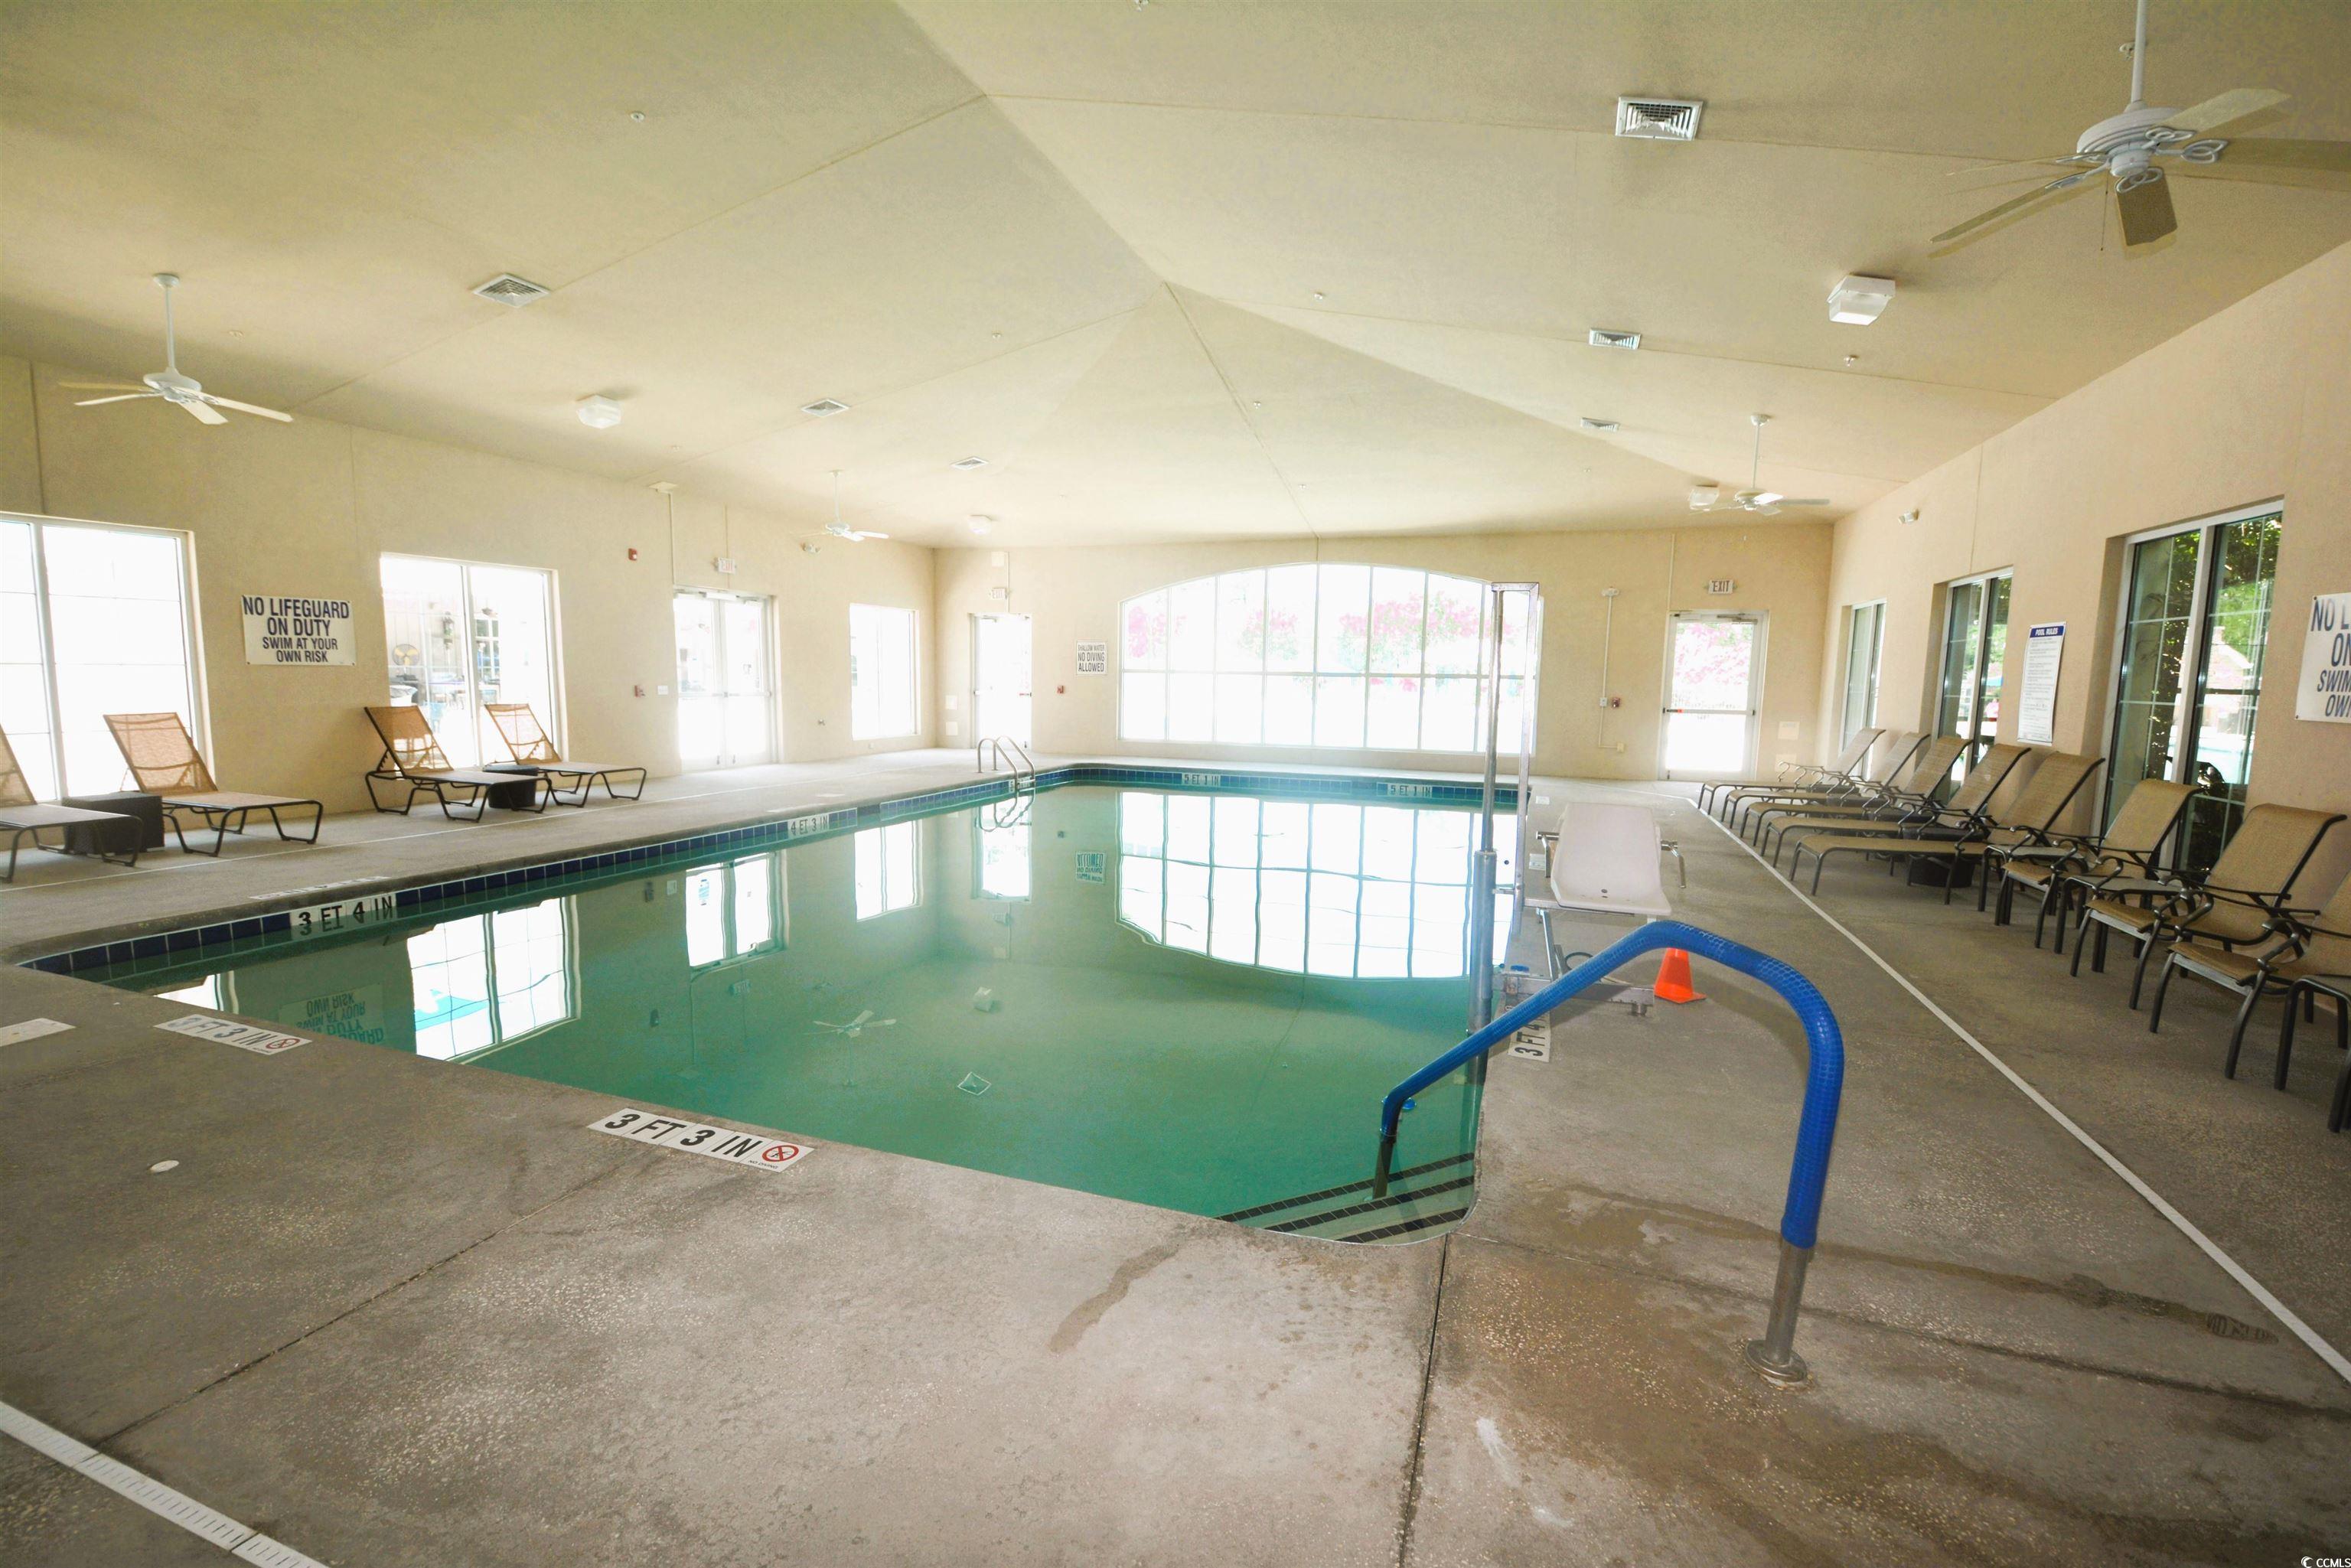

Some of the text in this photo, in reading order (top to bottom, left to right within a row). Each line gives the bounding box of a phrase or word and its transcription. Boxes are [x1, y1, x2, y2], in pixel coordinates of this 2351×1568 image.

[1712, 580, 1730, 592] EXIT
[243, 596, 350, 618] NO LIFEGUARD
[2310, 598, 2335, 631] NO
[267, 617, 331, 636] ON DUTY
[2046, 627, 2058, 635] RULES
[262, 637, 338, 650] SWIM AT YOUR
[276, 650, 328, 663] OWN RISK
[1078, 652, 1105, 662] NO DIVING
[1078, 663, 1104, 672] ALLOWED
[791, 820, 796, 830] 4
[298, 895, 393, 925] 3 FT 4 IN
[214, 1028, 249, 1038] 3
[232, 1032, 278, 1046] IN
[1516, 1032, 1545, 1047] FT
[1515, 1047, 1544, 1057] 3
[605, 1113, 763, 1158] 3 FT 3 IN
